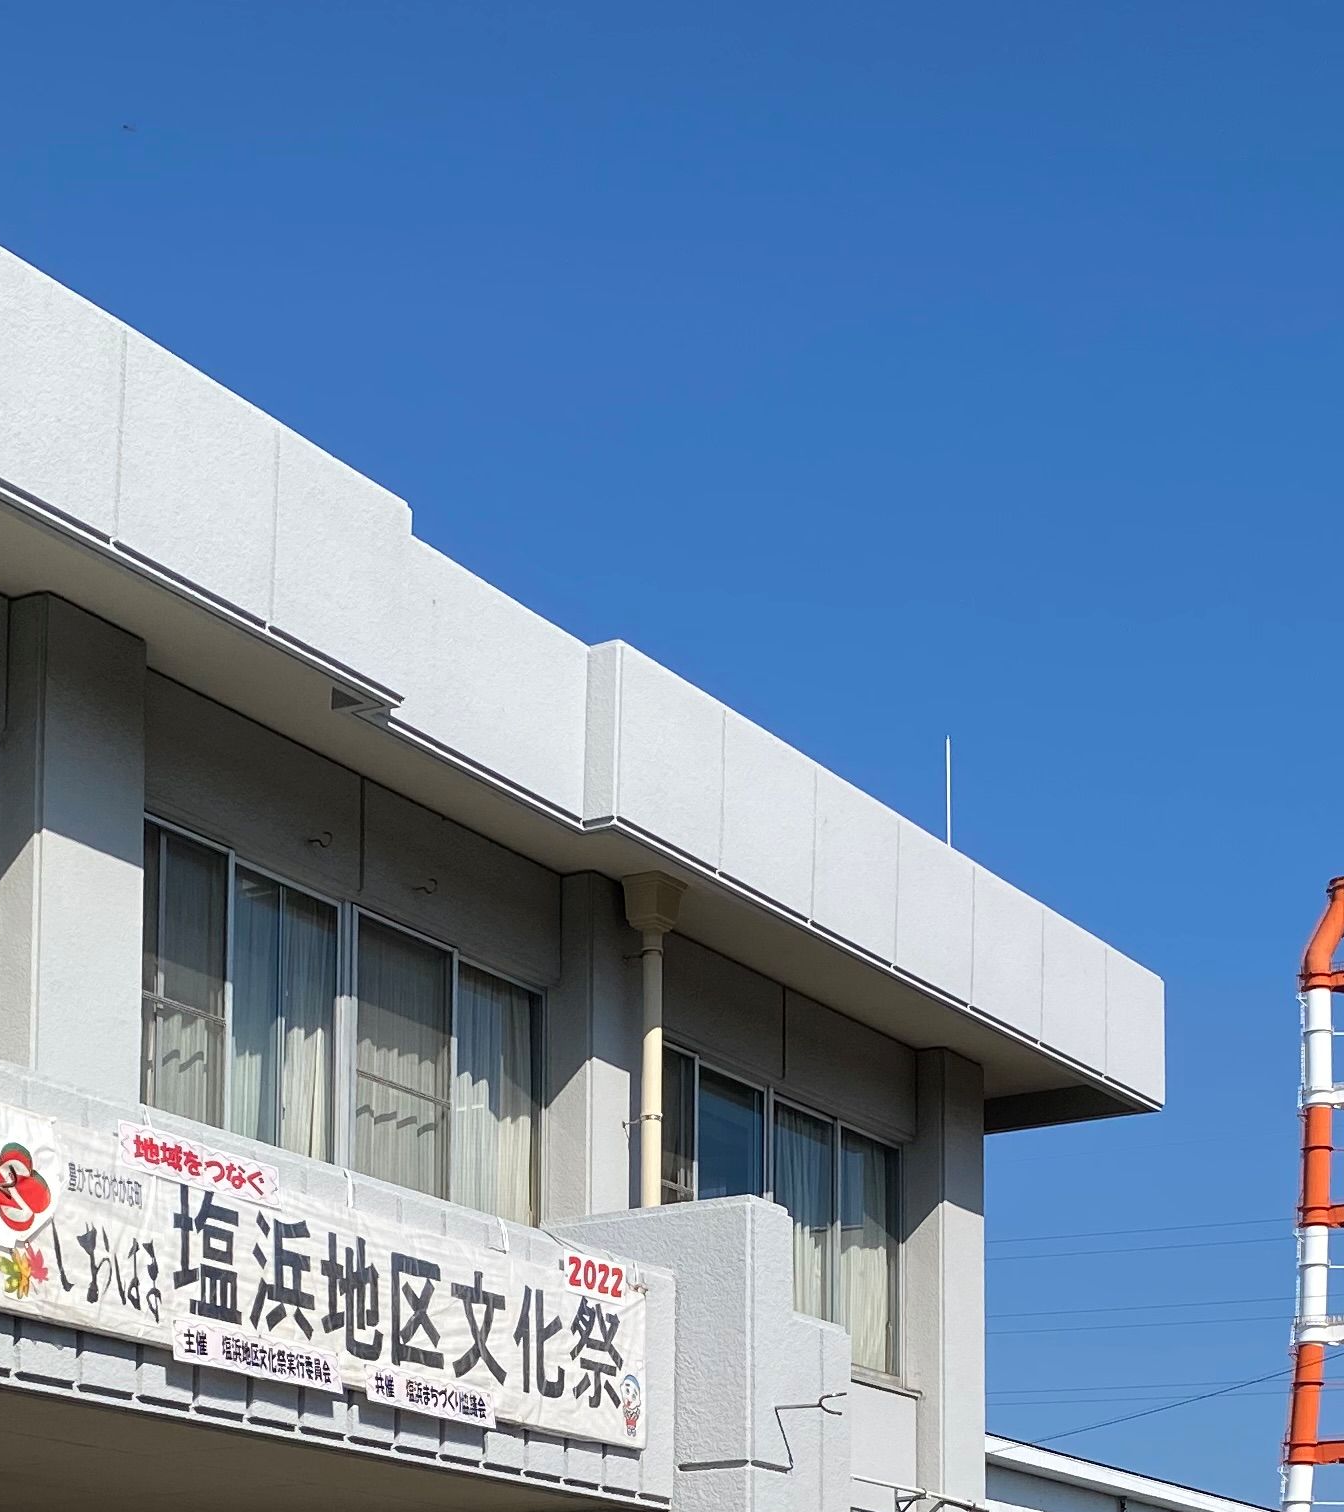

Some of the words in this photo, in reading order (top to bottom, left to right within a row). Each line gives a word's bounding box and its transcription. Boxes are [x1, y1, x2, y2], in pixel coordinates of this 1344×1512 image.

[133, 1135, 267, 1197] 地域をつなぐ
[51, 1217, 163, 1324] しおはま
[173, 1184, 624, 1410] 塩浜地区文化祭
[568, 1255, 625, 1299] 2022
[183, 1328, 209, 1356] 主催
[221, 1334, 333, 1384] 塩浜地区文化祭実行委員会
[374, 1371, 396, 1399] 共催
[405, 1378, 488, 1420] 塩浜まちづくり協議会
